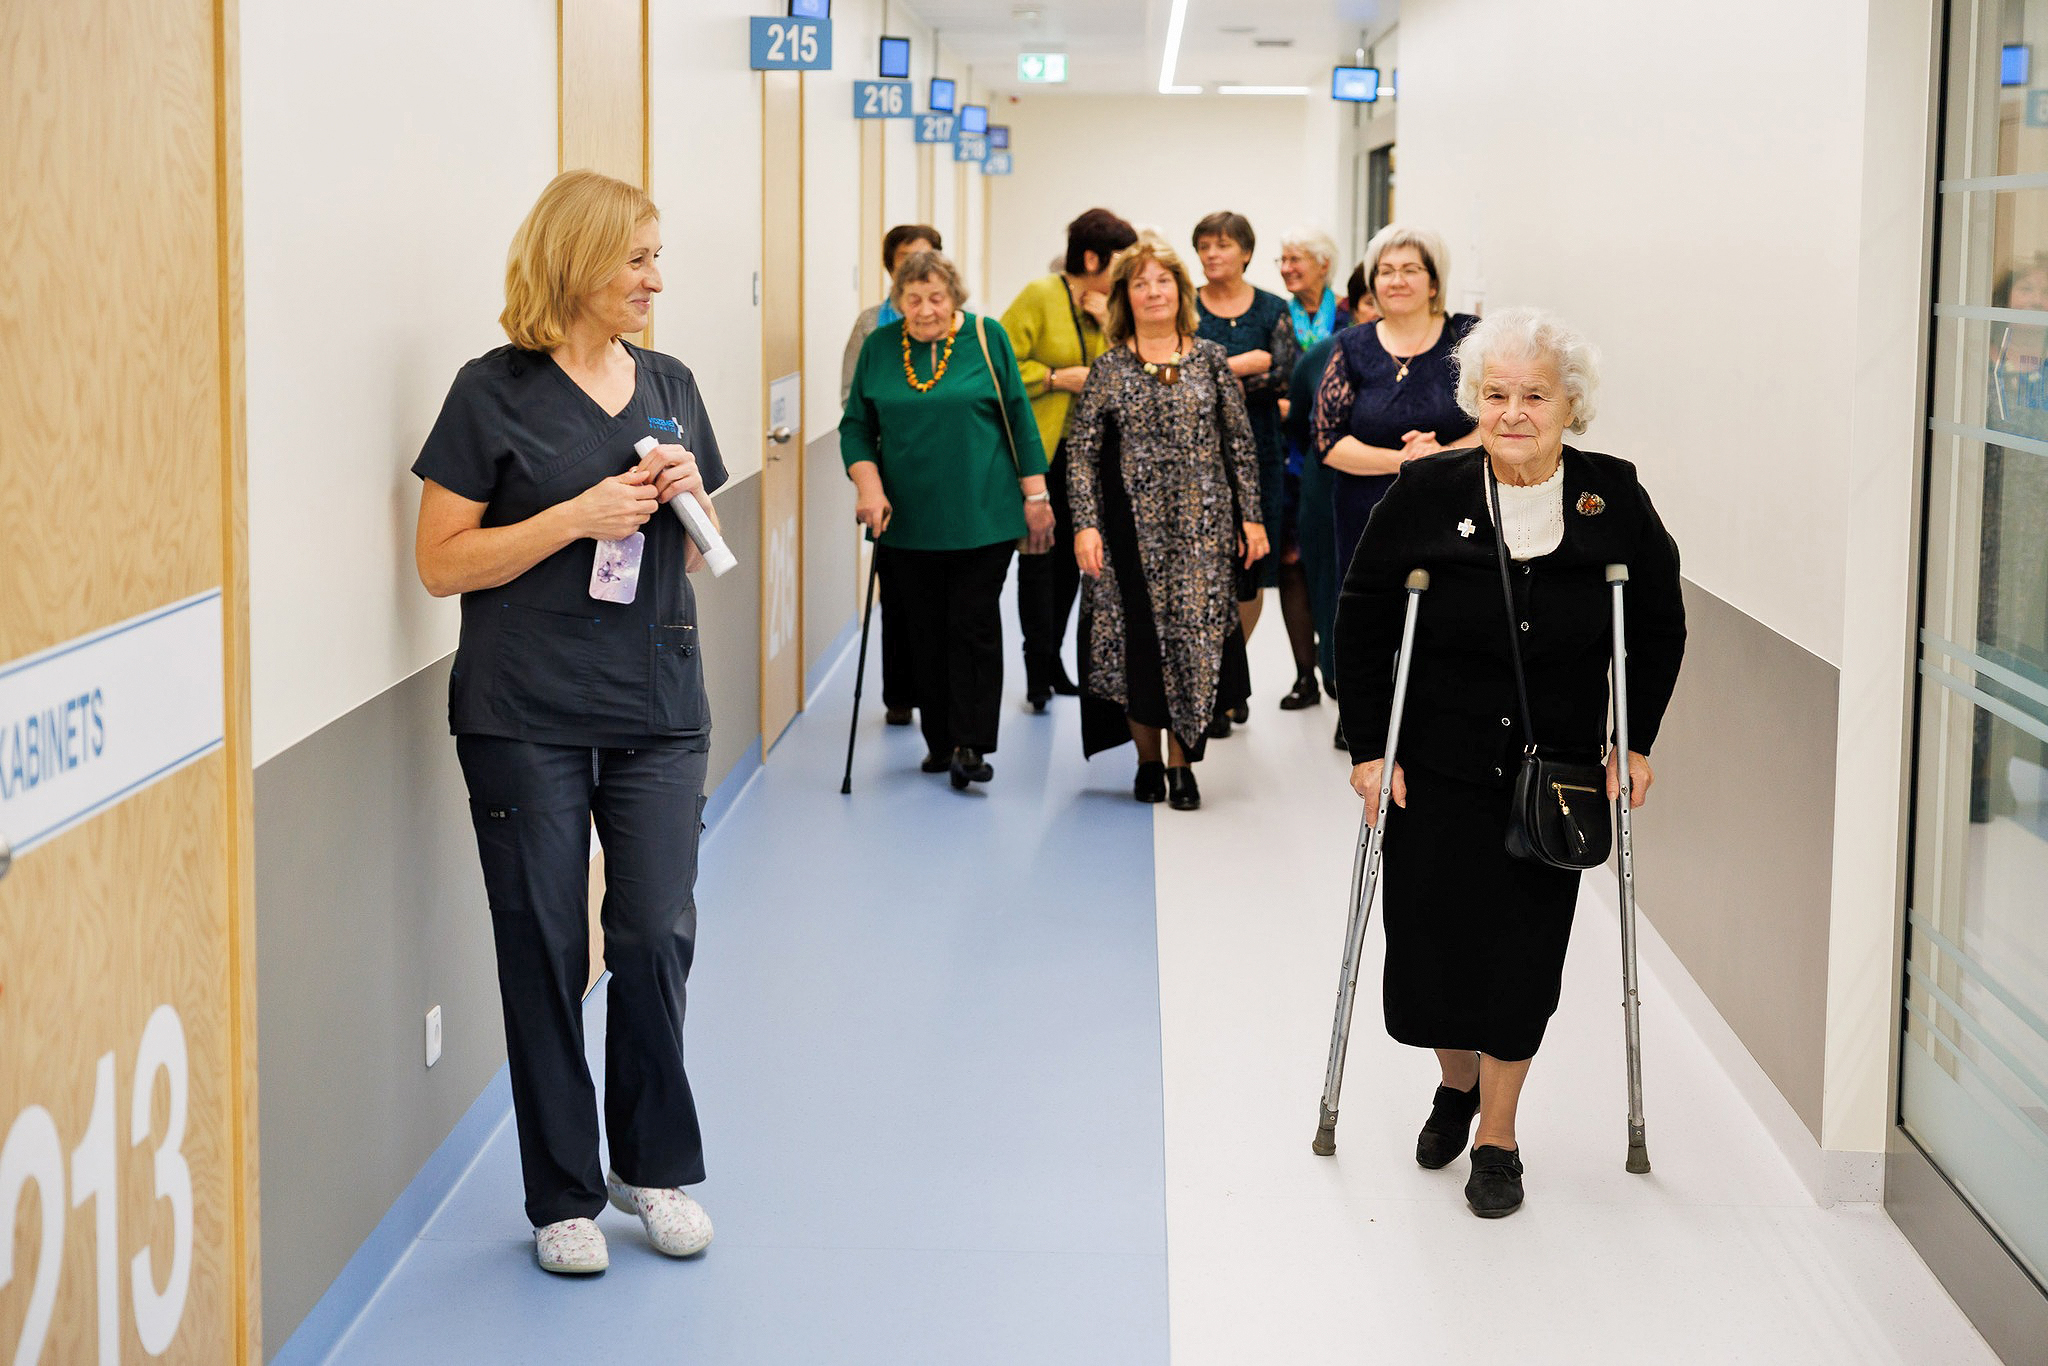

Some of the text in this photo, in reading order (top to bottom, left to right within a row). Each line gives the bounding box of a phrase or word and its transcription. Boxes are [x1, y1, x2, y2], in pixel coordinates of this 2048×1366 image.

[767, 24, 818, 63] 215
[864, 85, 904, 114] 216
[922, 117, 954, 141] 217
[0, 1003, 194, 1366] 213
